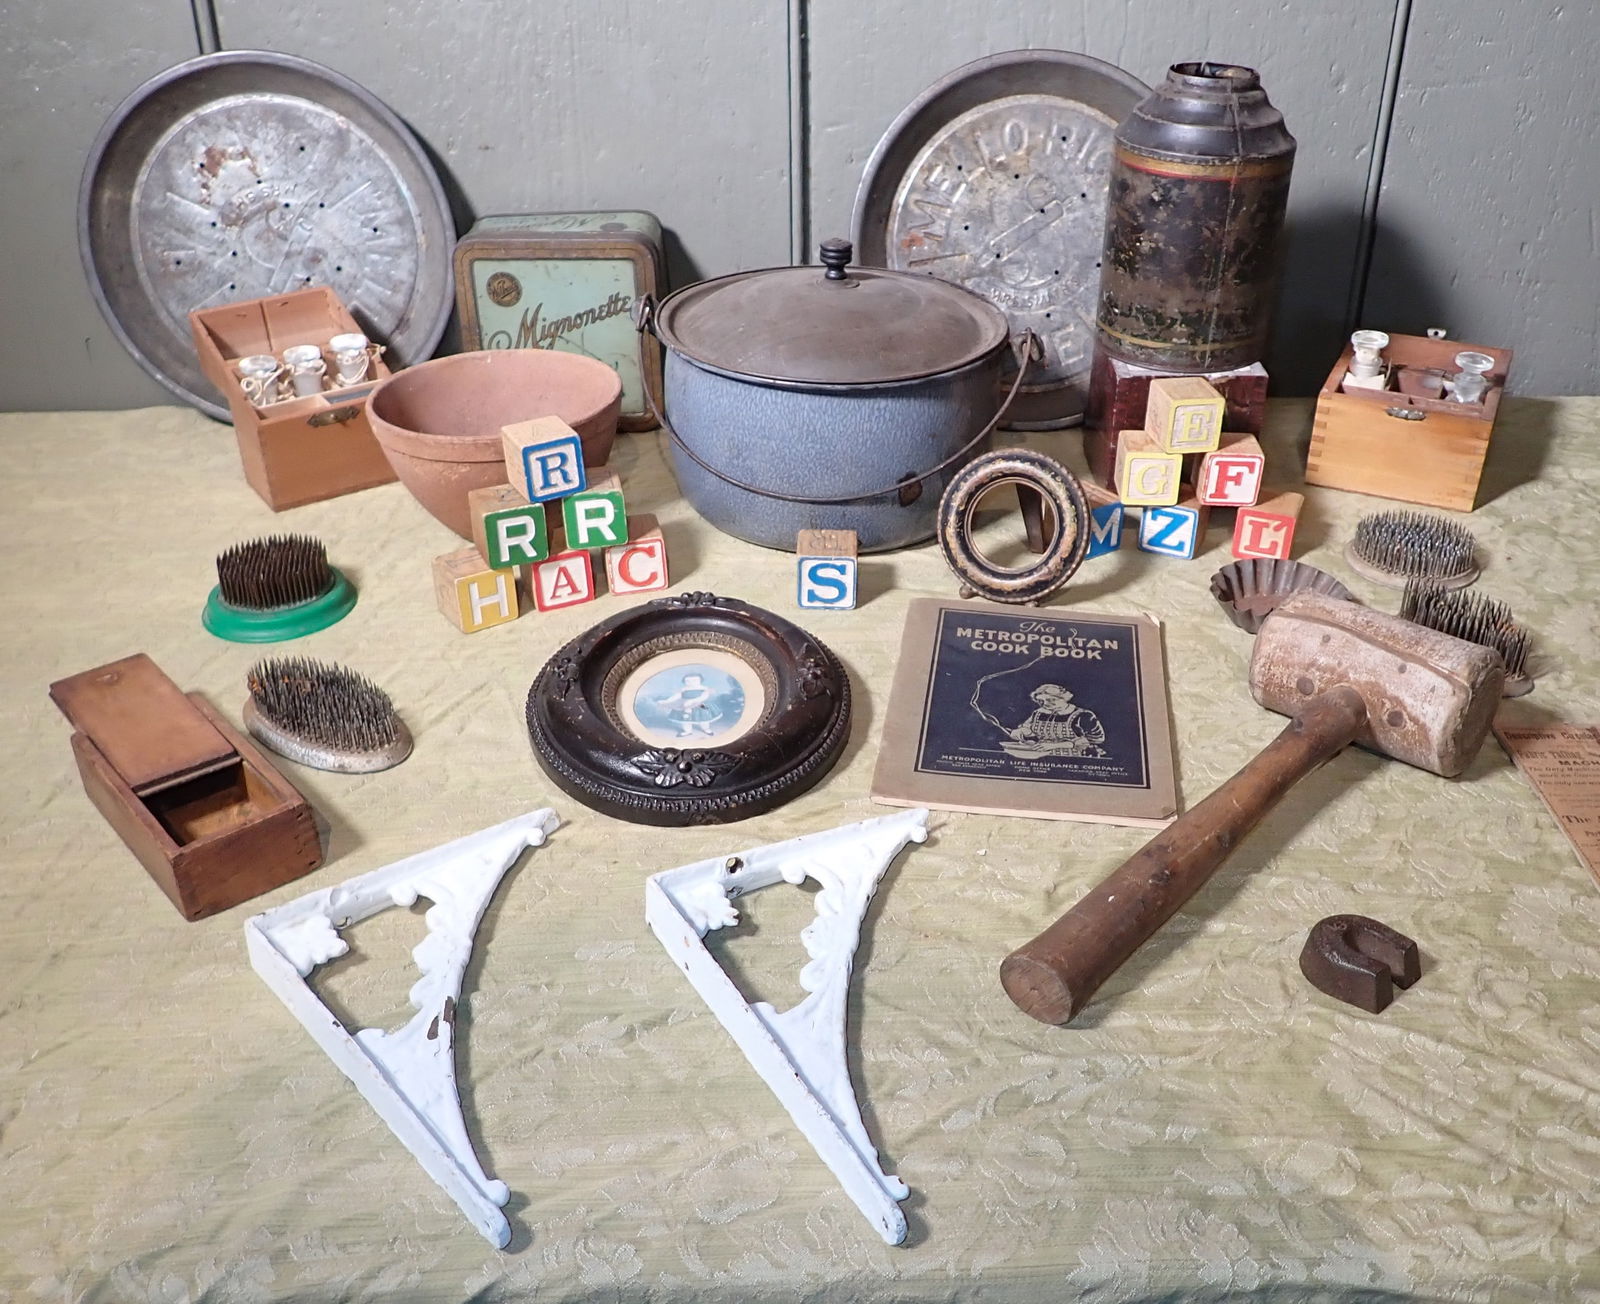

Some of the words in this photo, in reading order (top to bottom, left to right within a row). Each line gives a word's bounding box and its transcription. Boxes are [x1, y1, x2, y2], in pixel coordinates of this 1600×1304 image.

[512, 291, 632, 350] Mignonette
[1182, 410, 1212, 443] E
[536, 451, 572, 490] R
[1209, 461, 1255, 500] F
[497, 515, 538, 562] R
[575, 499, 617, 544] R
[1087, 507, 1121, 555] M
[1147, 509, 1190, 553] Z
[1244, 519, 1287, 555] L
[550, 566, 582, 600] A
[618, 546, 658, 587] C
[807, 563, 847, 604] S
[469, 575, 510, 626] H
[956, 627, 1119, 650] METROPOLITAN
[1019, 621, 1056, 633] The
[971, 640, 1029, 655] COOK
[1040, 644, 1103, 660] BOOK
[941, 755, 1005, 765] METROPOLITAN
[1030, 761, 1080, 769] INSURANCE
[1083, 764, 1126, 772] COMPANY
[1562, 815, 1591, 824] The
